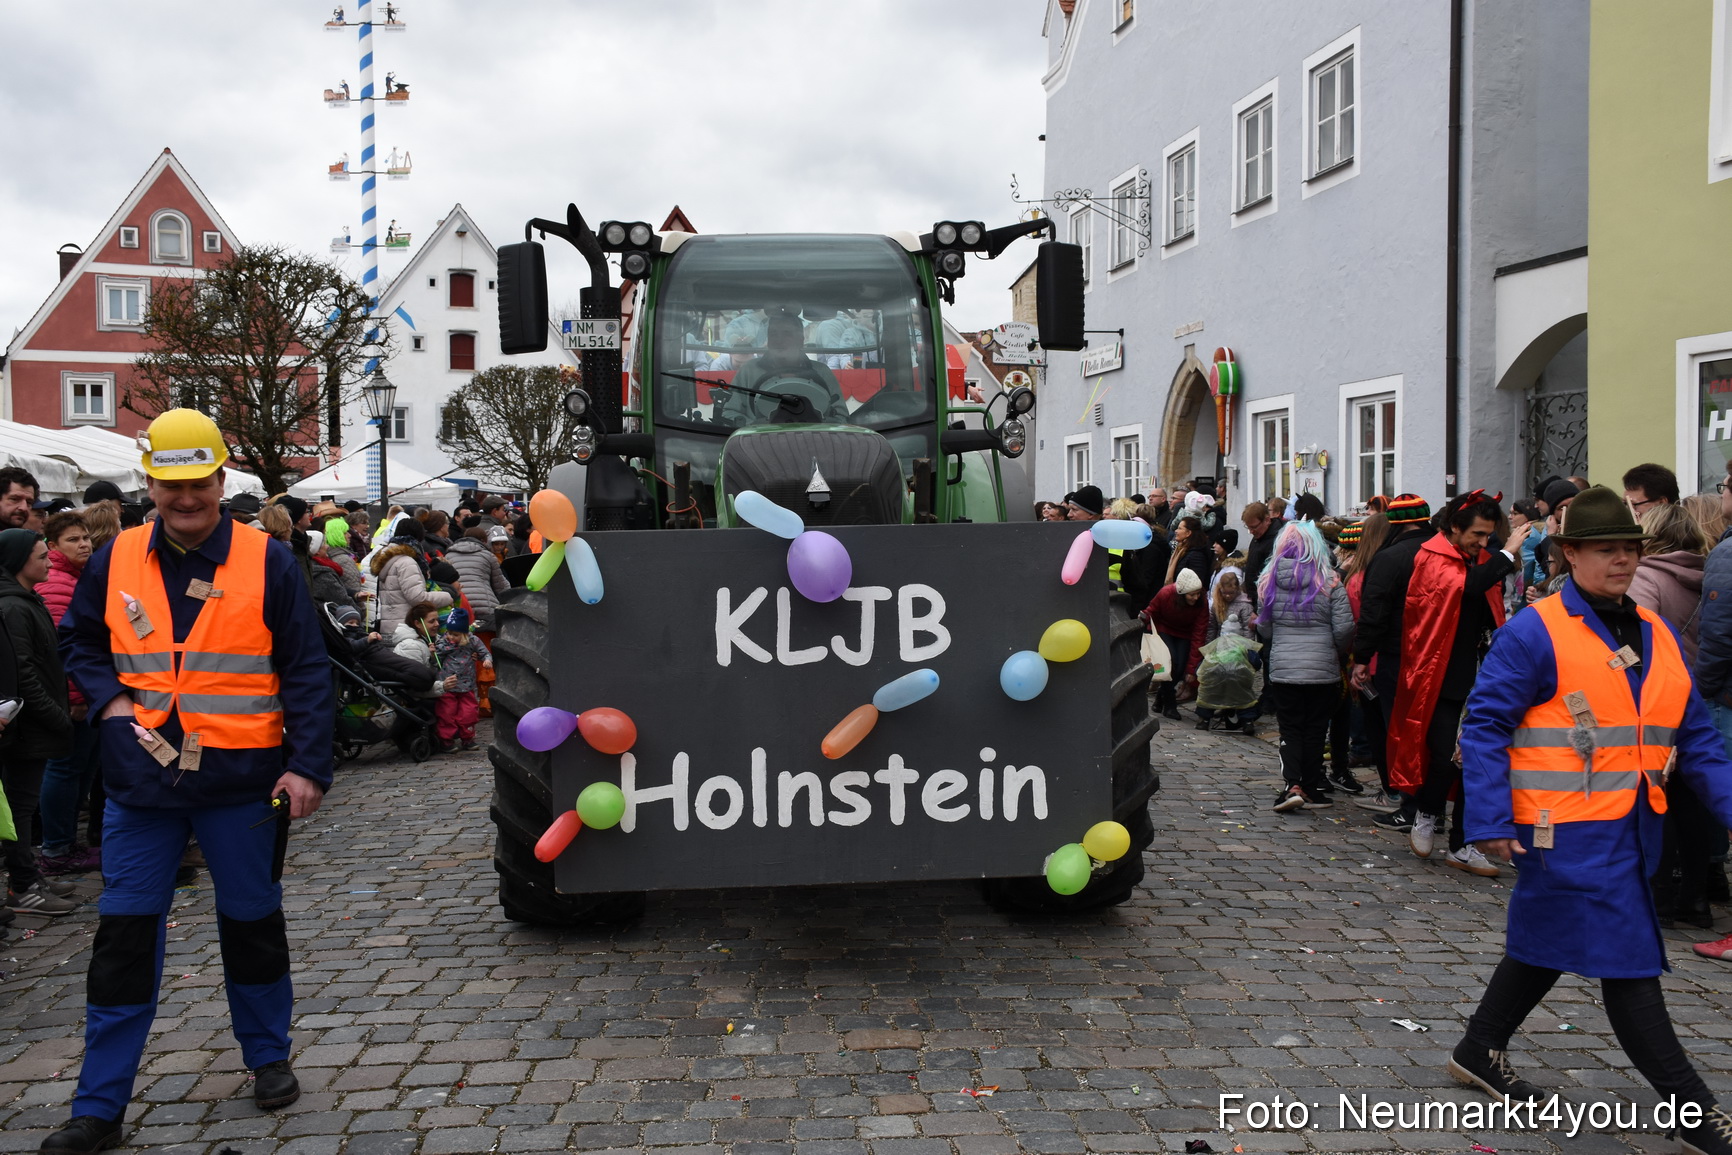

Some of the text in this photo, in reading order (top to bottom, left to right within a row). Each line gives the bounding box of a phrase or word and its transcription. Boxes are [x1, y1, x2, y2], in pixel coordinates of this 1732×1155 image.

[576, 322, 594, 334] NM
[568, 335, 614, 348] ML 514
[1003, 339, 1029, 348] Eisdiel
[1709, 378, 1732, 394] FA
[714, 583, 952, 667] KLJB
[619, 746, 1049, 834] Holnstein
